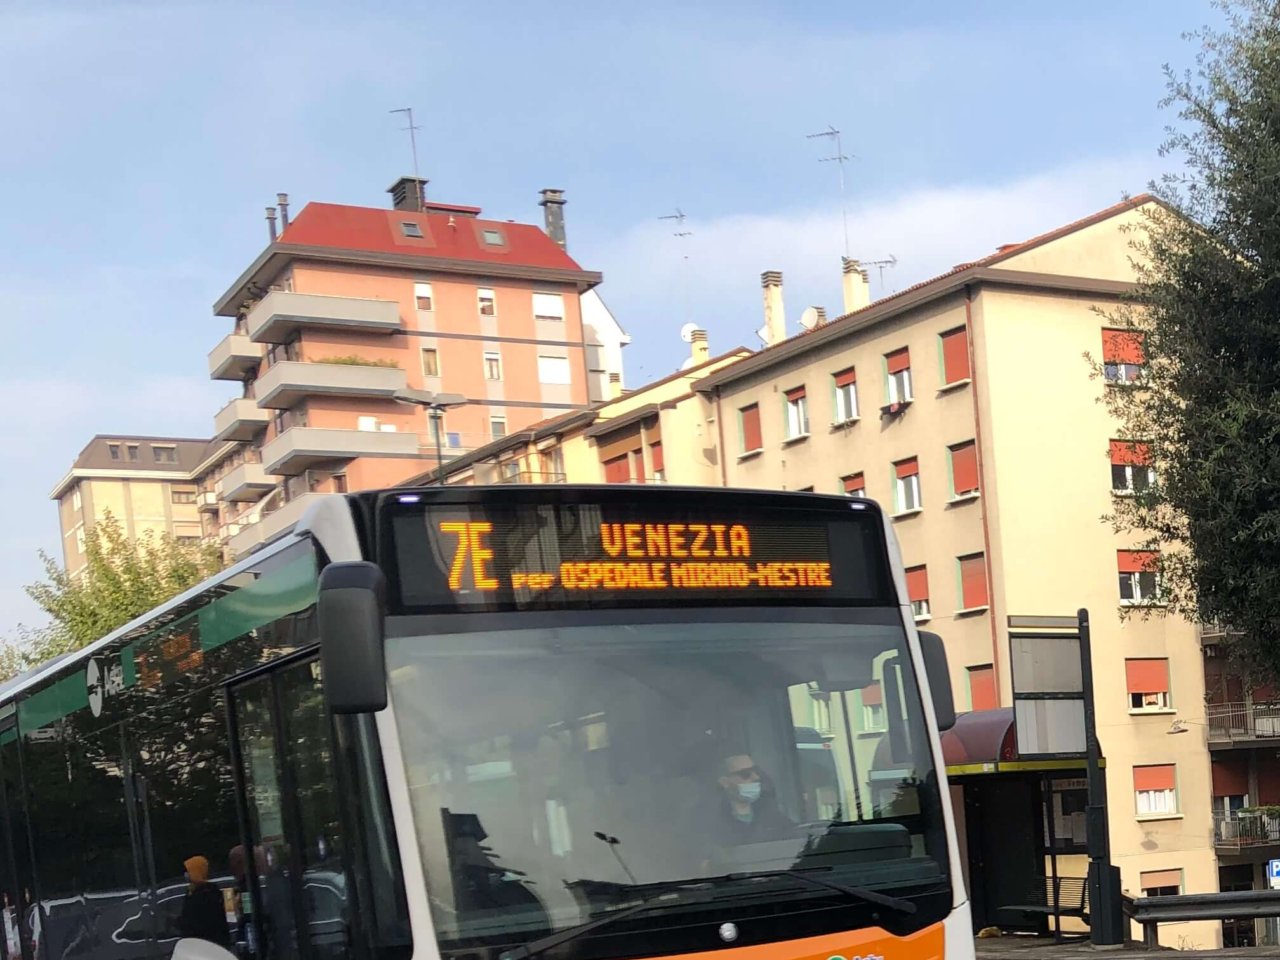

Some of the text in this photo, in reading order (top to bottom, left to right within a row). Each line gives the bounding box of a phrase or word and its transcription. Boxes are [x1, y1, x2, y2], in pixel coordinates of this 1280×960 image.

[440, 522, 499, 590] 7E
[600, 523, 752, 557] VENEZIA
[560, 562, 669, 589] OSPEDALE
[670, 561, 833, 588] MIRANO-MESTRE
